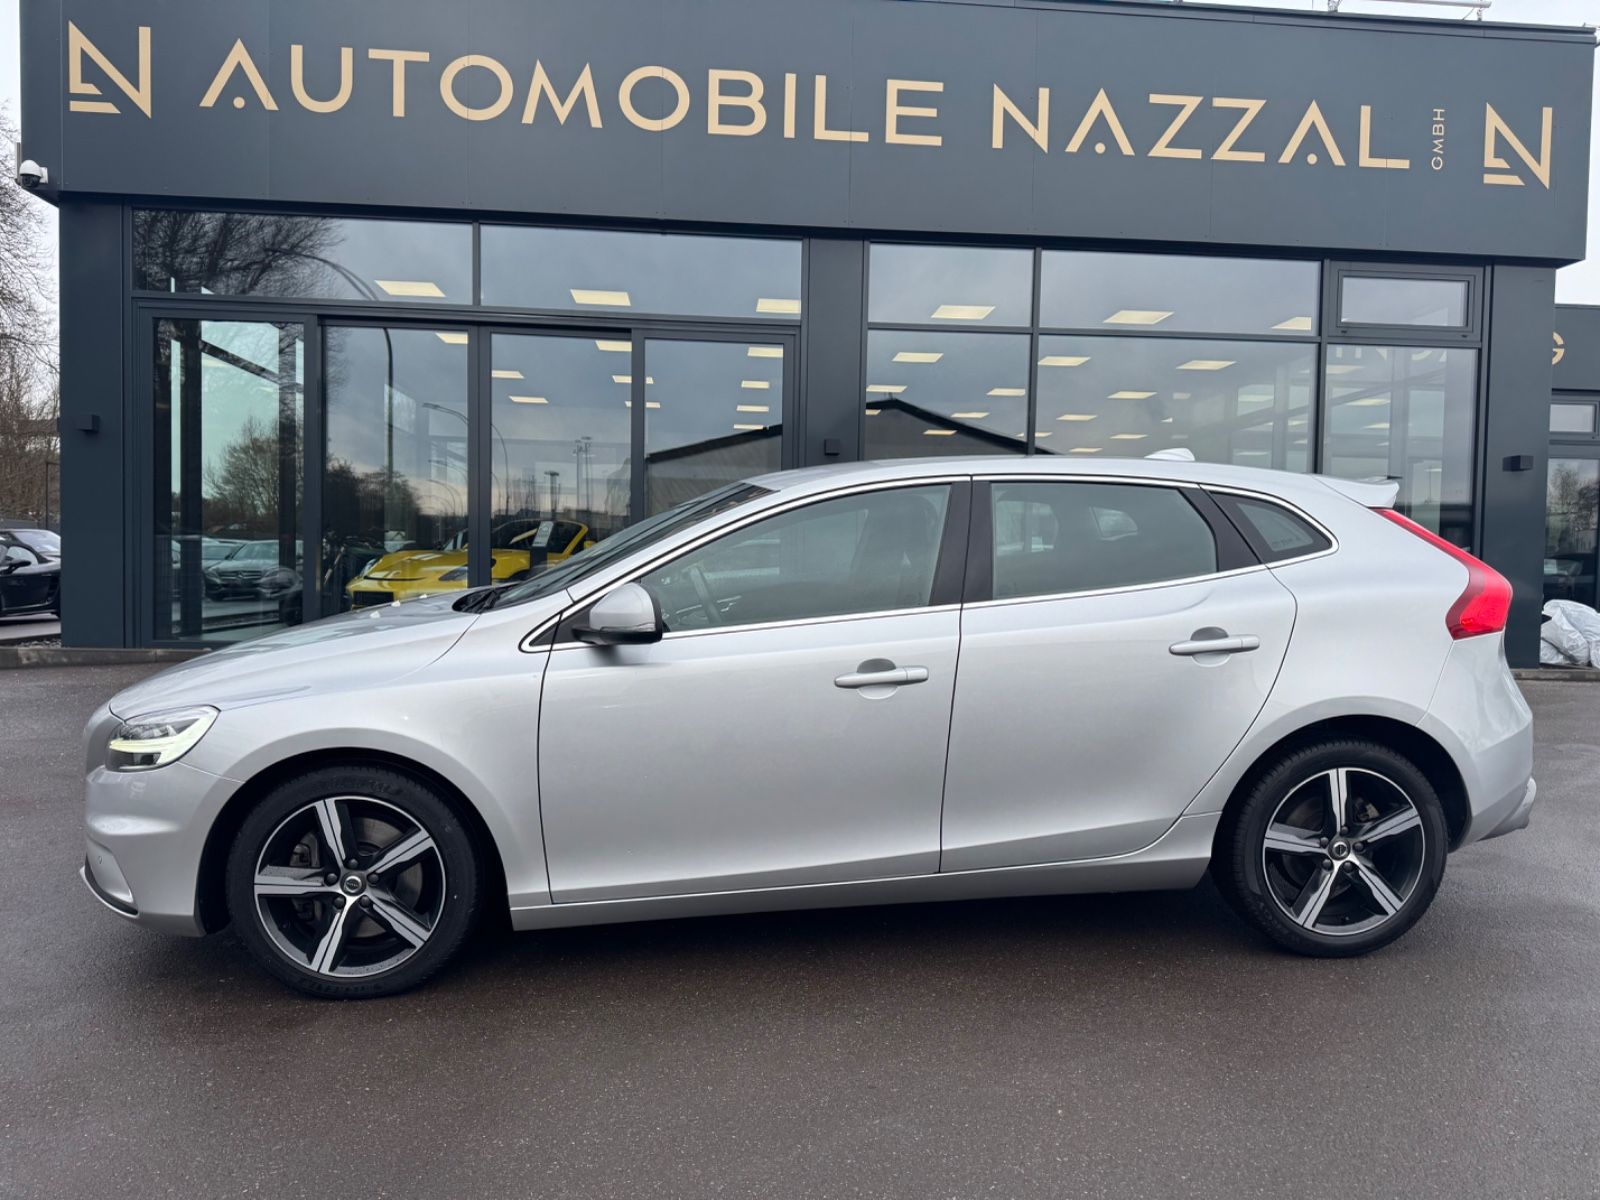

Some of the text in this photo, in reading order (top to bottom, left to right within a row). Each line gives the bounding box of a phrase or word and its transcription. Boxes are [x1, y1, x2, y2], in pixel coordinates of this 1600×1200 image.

[201, 41, 1410, 169] AUTOMOBILE NAZZAL
[1431, 108, 1446, 170] GMBH
